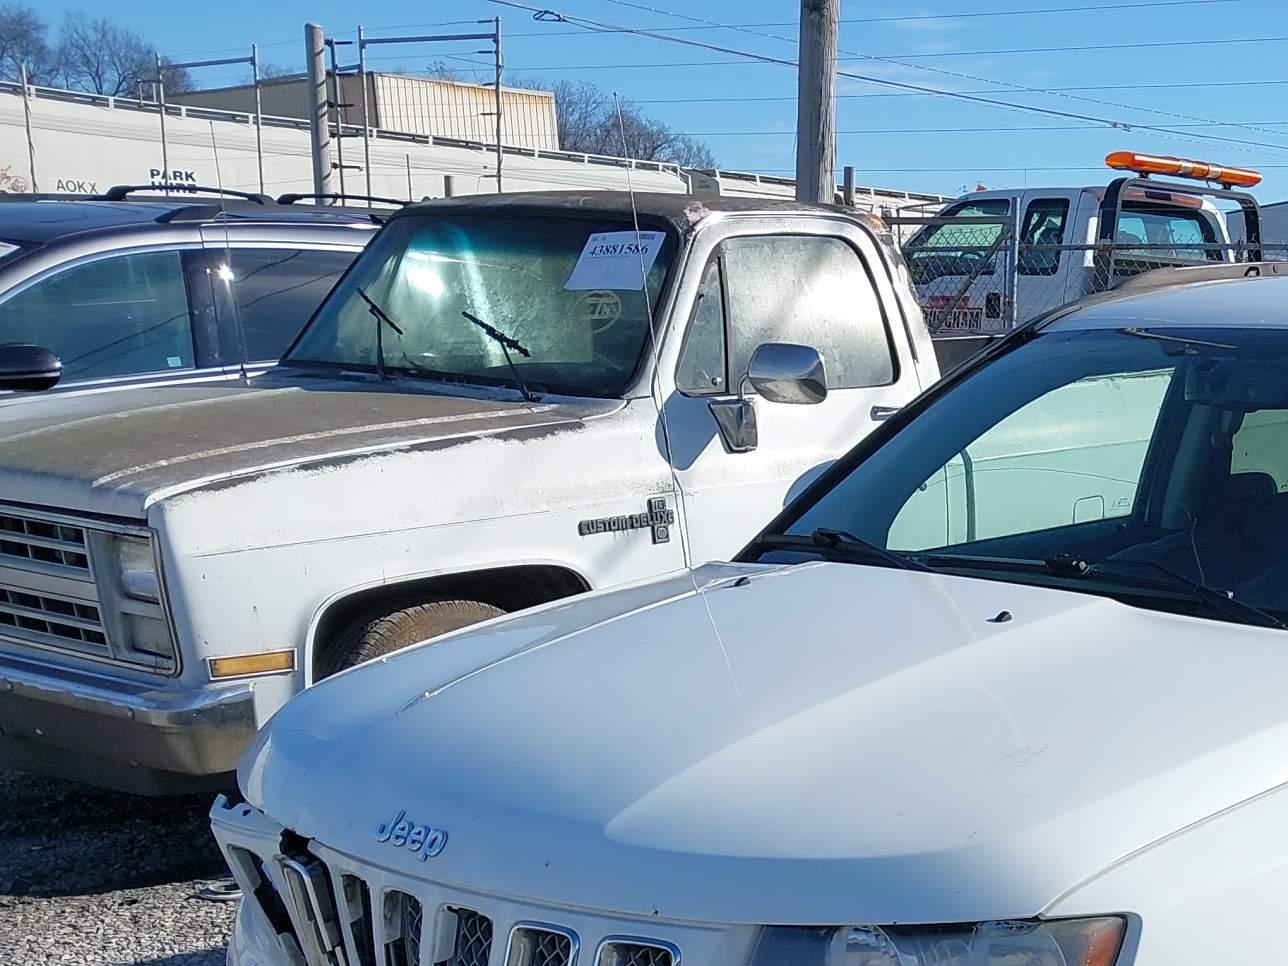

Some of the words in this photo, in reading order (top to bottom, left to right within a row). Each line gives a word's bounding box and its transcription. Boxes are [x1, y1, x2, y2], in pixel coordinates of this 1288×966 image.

[150, 169, 196, 181] PARK
[56, 179, 99, 194] AOKX
[589, 243, 648, 256] 43881586
[629, 510, 675, 530] DELUXE
[376, 809, 449, 863] Jeep
